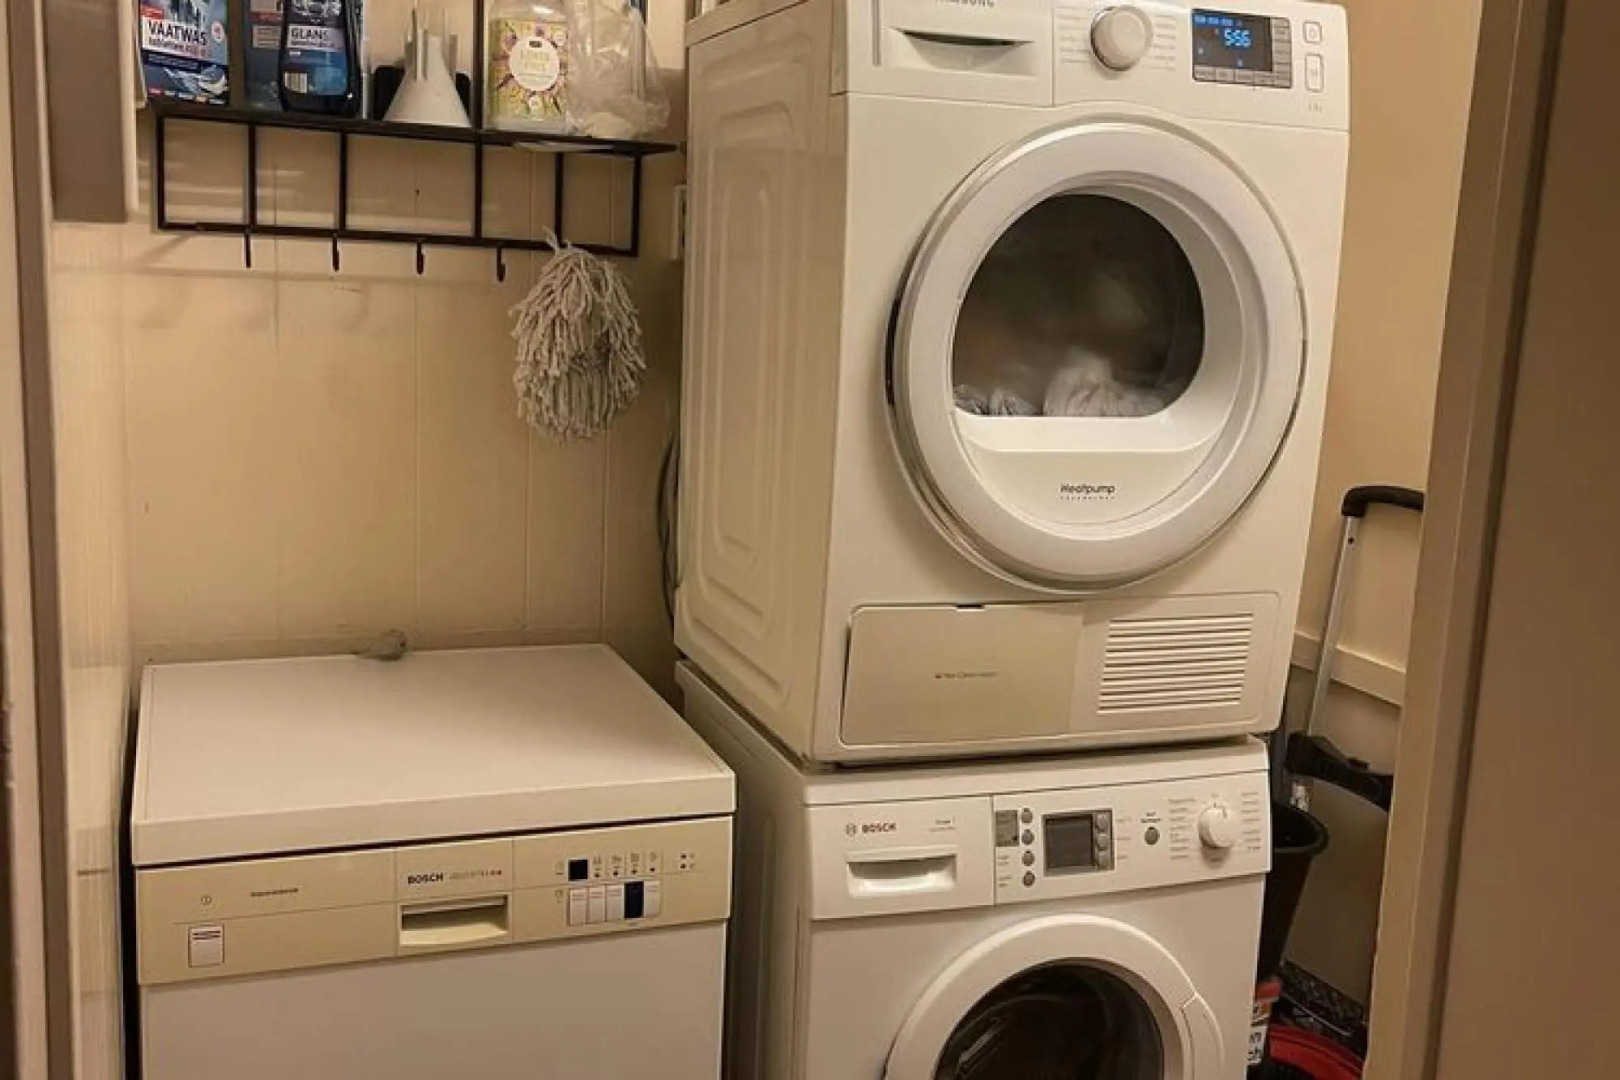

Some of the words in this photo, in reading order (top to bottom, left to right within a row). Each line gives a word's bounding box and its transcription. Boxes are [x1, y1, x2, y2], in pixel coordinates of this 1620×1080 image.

[148, 20, 208, 46] VAATWAS
[291, 27, 328, 41] GLANS
[861, 822, 896, 834] BOSCH
[407, 872, 444, 884] BOSCH
